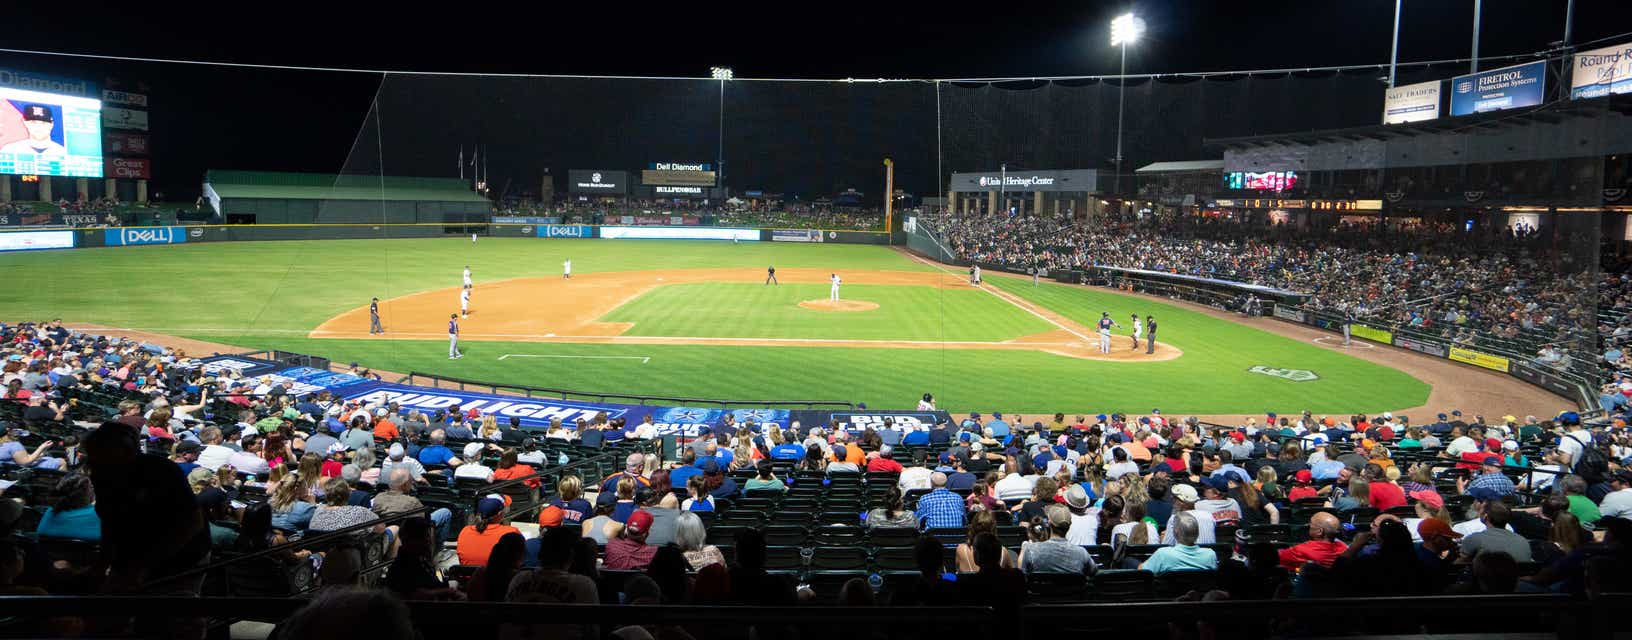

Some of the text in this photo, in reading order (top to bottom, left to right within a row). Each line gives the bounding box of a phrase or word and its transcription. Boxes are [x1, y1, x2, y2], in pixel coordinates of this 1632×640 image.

[1580, 51, 1619, 68] Round
[0, 70, 87, 96] Diamond
[1479, 71, 1523, 85] FIRETROL
[1478, 77, 1537, 92] Protection Systems
[112, 158, 145, 168] Great
[672, 163, 703, 171] Diamond
[116, 167, 141, 178] Clips
[1006, 176, 1032, 187] Heritage
[1032, 176, 1054, 185] Center
